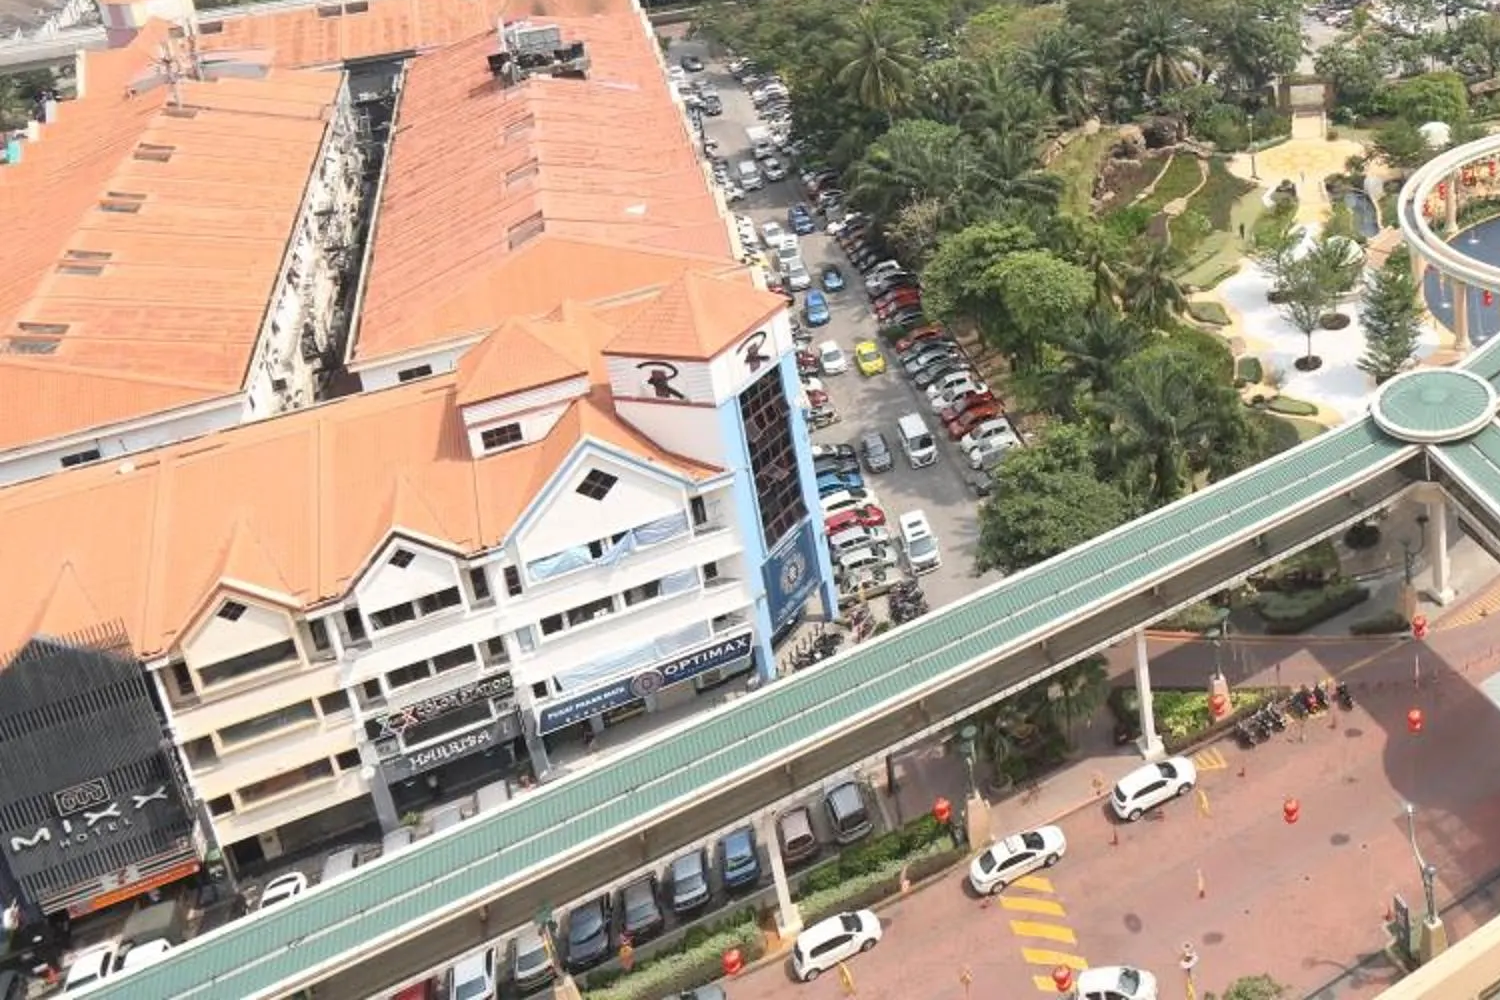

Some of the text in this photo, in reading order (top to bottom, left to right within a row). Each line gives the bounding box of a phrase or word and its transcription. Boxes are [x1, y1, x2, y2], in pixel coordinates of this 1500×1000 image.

[664, 638, 748, 675] OPTIMAX
[11, 786, 168, 850] MIXX
[59, 817, 132, 849] HOTEL
